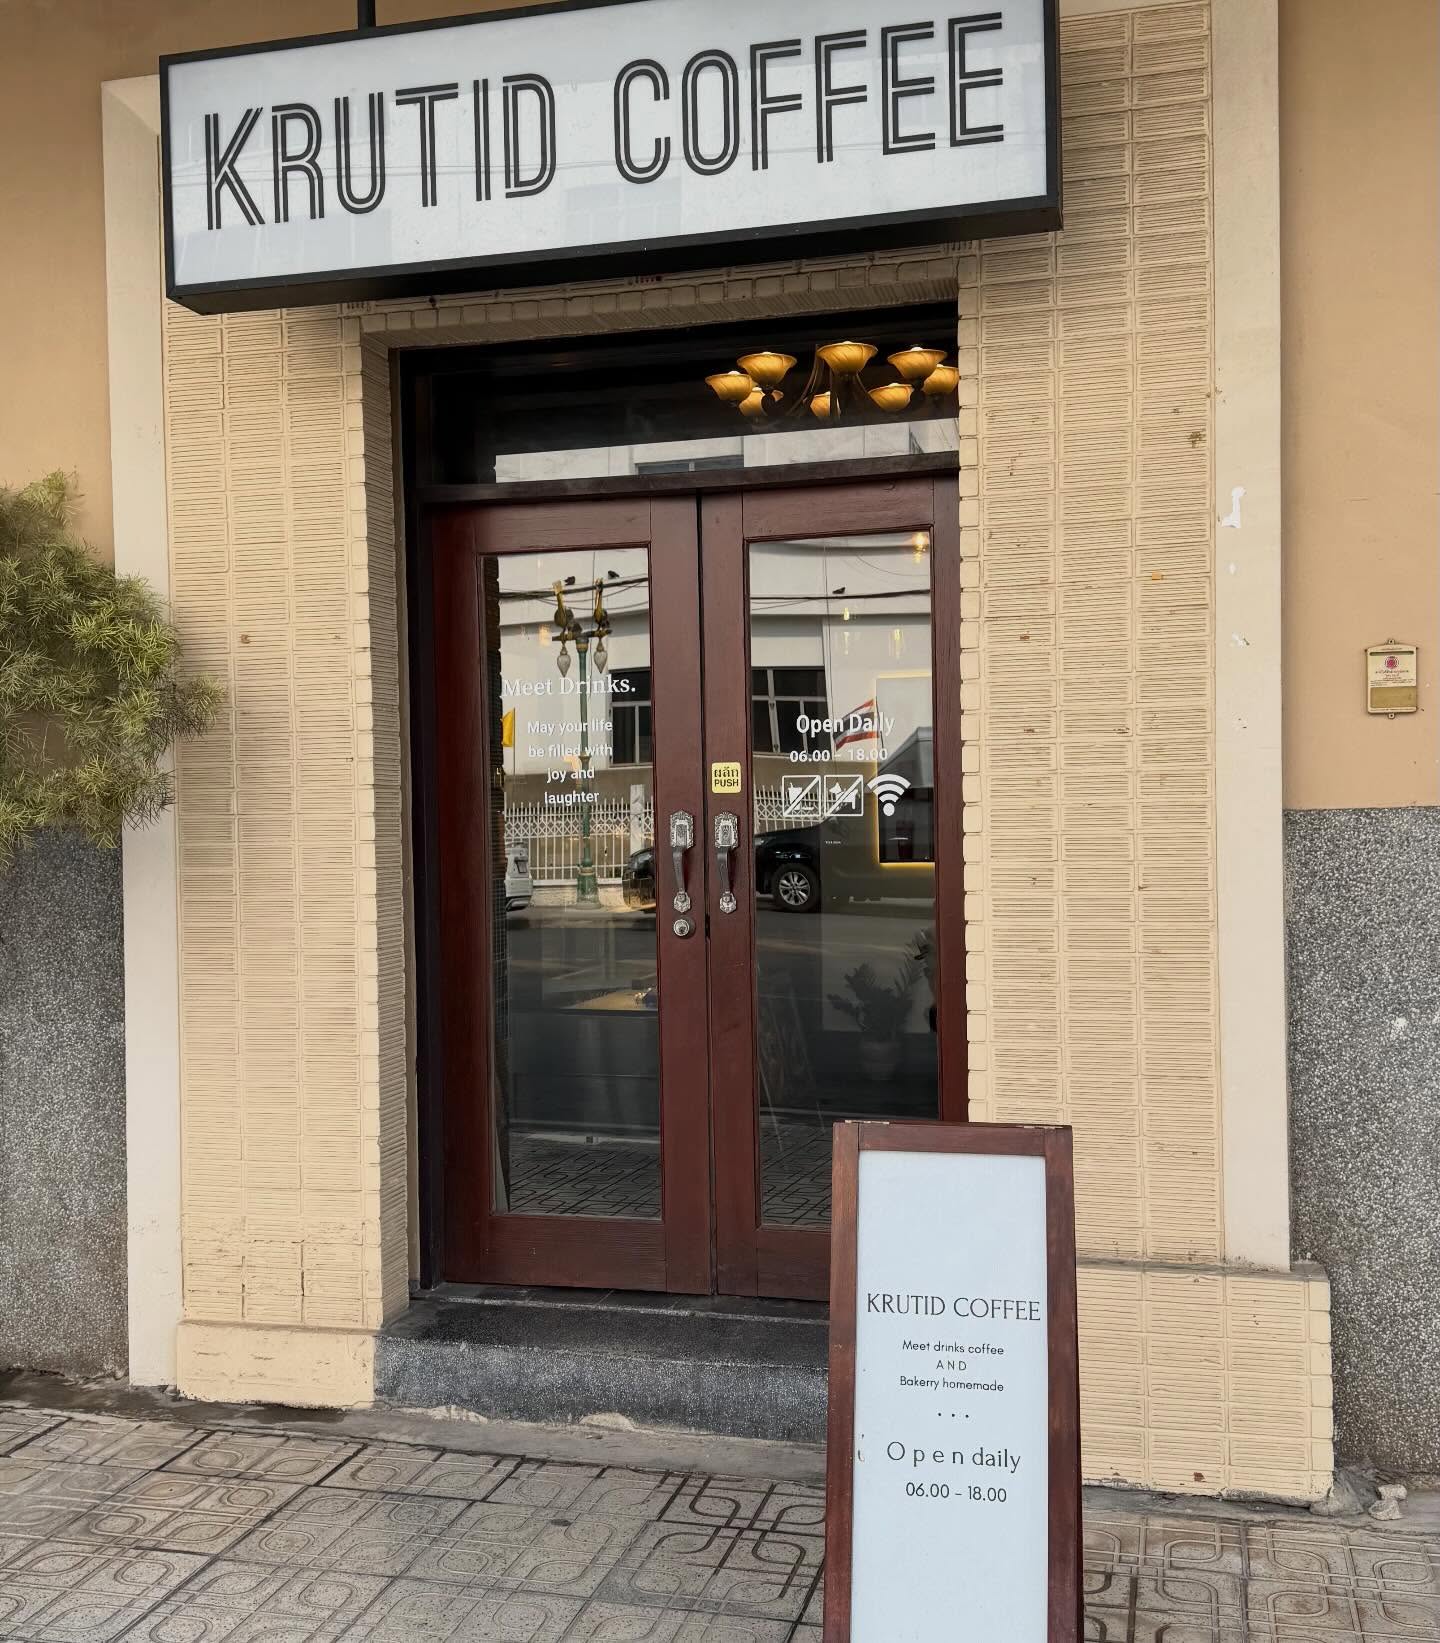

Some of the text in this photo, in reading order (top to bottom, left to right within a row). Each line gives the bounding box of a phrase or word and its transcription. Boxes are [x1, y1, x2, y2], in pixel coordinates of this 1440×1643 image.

[204, 11, 1005, 231] KRUTID COFFEE
[501, 674, 637, 697] Meet Drinks.
[527, 718, 613, 736] May your life
[796, 711, 895, 738] Open Daily
[528, 743, 613, 758] be filled with
[789, 749, 831, 763] 06.00
[846, 748, 888, 761] 18.00
[546, 767, 595, 783] joy and
[713, 766, 739, 778] ผลัก
[714, 778, 739, 788] PUSH
[543, 790, 600, 806] laughter
[866, 1292, 1041, 1321] KRUTID COFFEE
[902, 1339, 1005, 1356] Meet drinks coffee
[899, 1375, 1005, 1392] Bakerry homemade
[886, 1441, 1021, 1474] Open daily
[905, 1481, 950, 1499] 06.00
[967, 1485, 1008, 1503] 18.00
